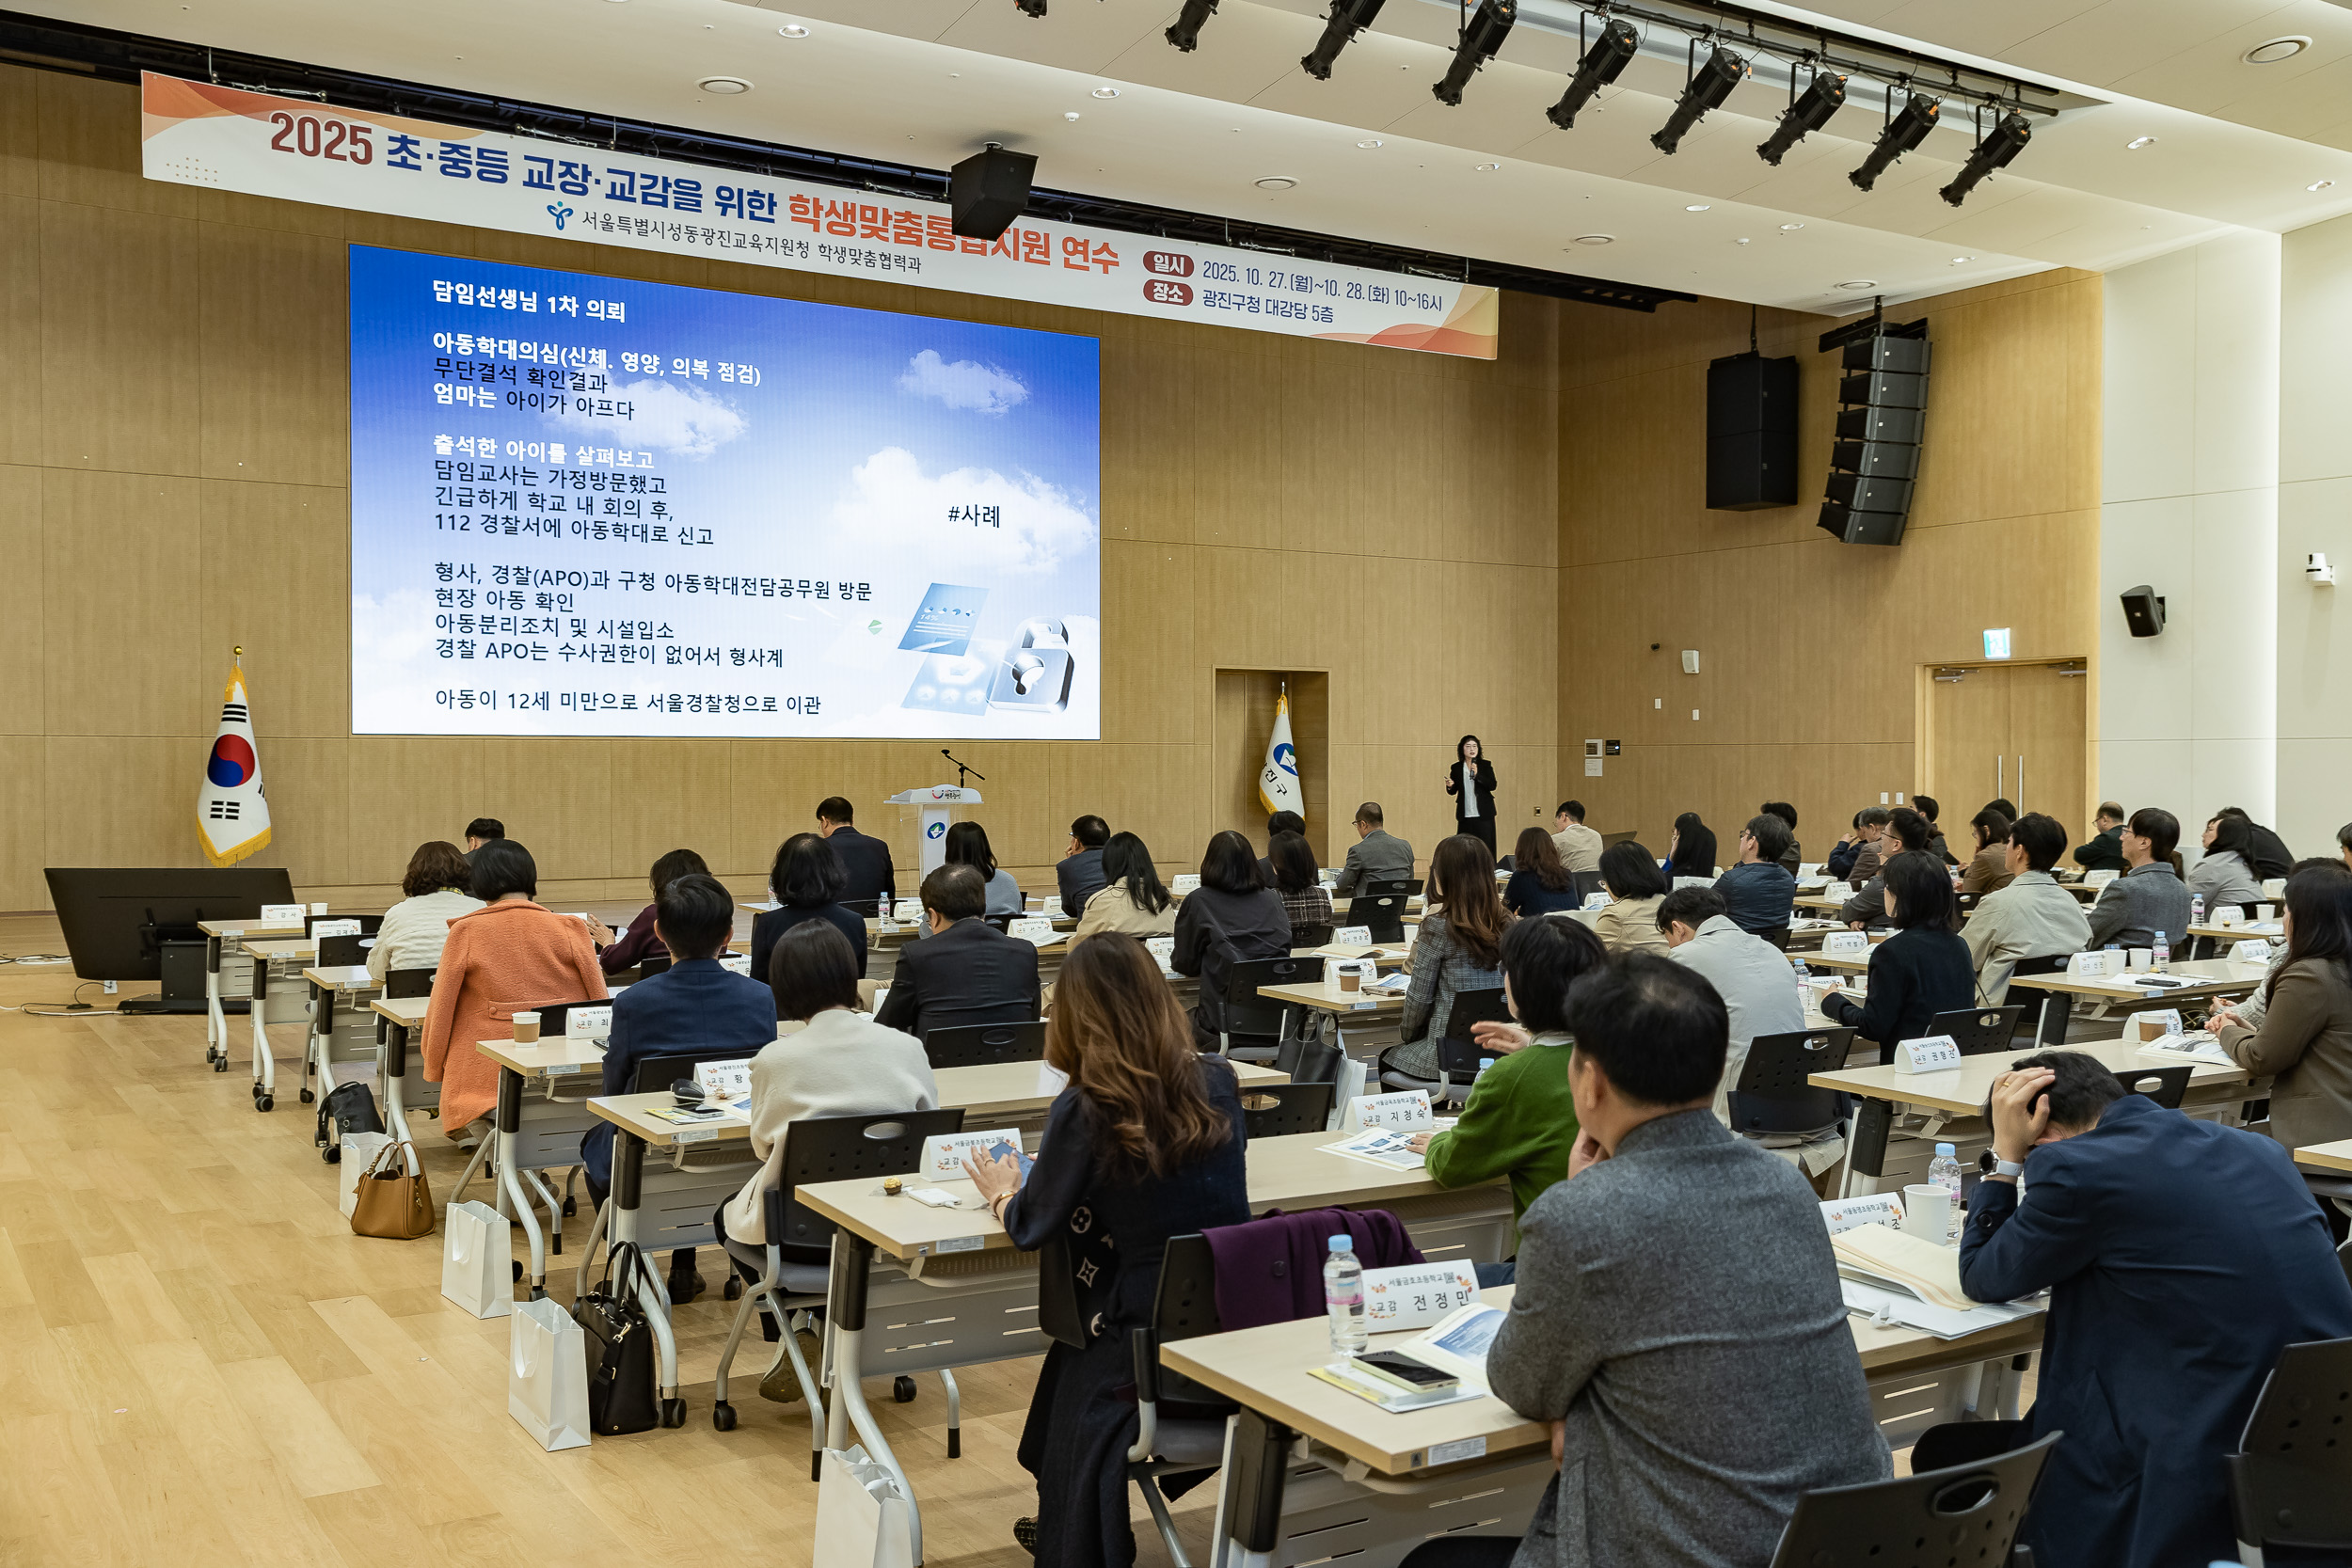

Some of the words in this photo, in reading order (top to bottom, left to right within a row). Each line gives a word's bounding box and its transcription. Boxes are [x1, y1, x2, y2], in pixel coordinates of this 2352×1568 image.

[270, 111, 373, 166] 2025
[387, 135, 509, 185] 초·중등
[523, 154, 703, 214] 교장·교감을
[715, 188, 777, 225] 위한
[1062, 235, 1120, 275] 연수
[582, 210, 810, 261] 서울특별시성동광진교육지원청
[818, 243, 922, 275] 학생맞춤협력과
[1152, 254, 1184, 276] 일시
[433, 279, 537, 313] 담임선생님
[548, 296, 579, 319] 1차
[586, 300, 626, 323] 의뢰
[1152, 282, 1184, 304] 장소
[1203, 261, 1240, 282] 2025.
[1246, 269, 1263, 286] 10.
[1394, 288, 1442, 311] 10~16시
[1203, 289, 1261, 313] 광진구청
[1265, 298, 1308, 320] 대강당
[1311, 307, 1334, 324] 5층
[434, 358, 517, 384] 무단결석
[527, 367, 608, 394] 확인결과
[621, 351, 664, 376] 영양,
[672, 356, 709, 381] 의복
[718, 360, 761, 388] 점검)
[434, 382, 498, 408] 엄마는
[506, 390, 567, 416] 아이가
[576, 398, 635, 421] 아프다
[434, 434, 498, 460] 출석한
[506, 440, 567, 465] 아이를
[576, 445, 655, 470] 살펴보고
[435, 459, 539, 487] 담임교사는
[548, 468, 667, 495] 가정방문했고
[435, 485, 518, 512] 긴급하게
[528, 492, 566, 515] 학교
[577, 496, 594, 517] 내
[603, 498, 641, 520] 회의
[650, 500, 674, 523] 후,
[948, 504, 1000, 528] #사례
[436, 514, 470, 531] 112
[481, 515, 562, 539] 경찰서에
[571, 520, 669, 545] 아동학대로
[677, 526, 714, 546] 신고
[435, 562, 482, 586] 형사,
[492, 564, 610, 592] 경찰(APO)과
[618, 570, 656, 592] 구청
[665, 573, 831, 600] 아동학대전담공무원
[838, 580, 872, 601] 방문
[435, 588, 477, 610] 현장
[486, 590, 527, 611] 아동
[535, 592, 574, 613] 확인
[436, 613, 559, 638] 아동분리조치
[570, 617, 588, 639] 및
[597, 618, 675, 640] 시설입소
[436, 638, 477, 659] 경찰
[485, 641, 549, 661] APO는
[558, 641, 656, 665] 수사권한이
[666, 645, 722, 667] 없어서
[729, 647, 783, 668] 형사계
[436, 689, 498, 711] 아동이
[508, 690, 549, 711] 12세
[560, 691, 638, 712] 미만으로
[647, 693, 778, 715] 서울경찰청으로
[787, 695, 821, 715] 이관
[944, 1157, 960, 1165] 교감
[1376, 1300, 1397, 1312] 교감
